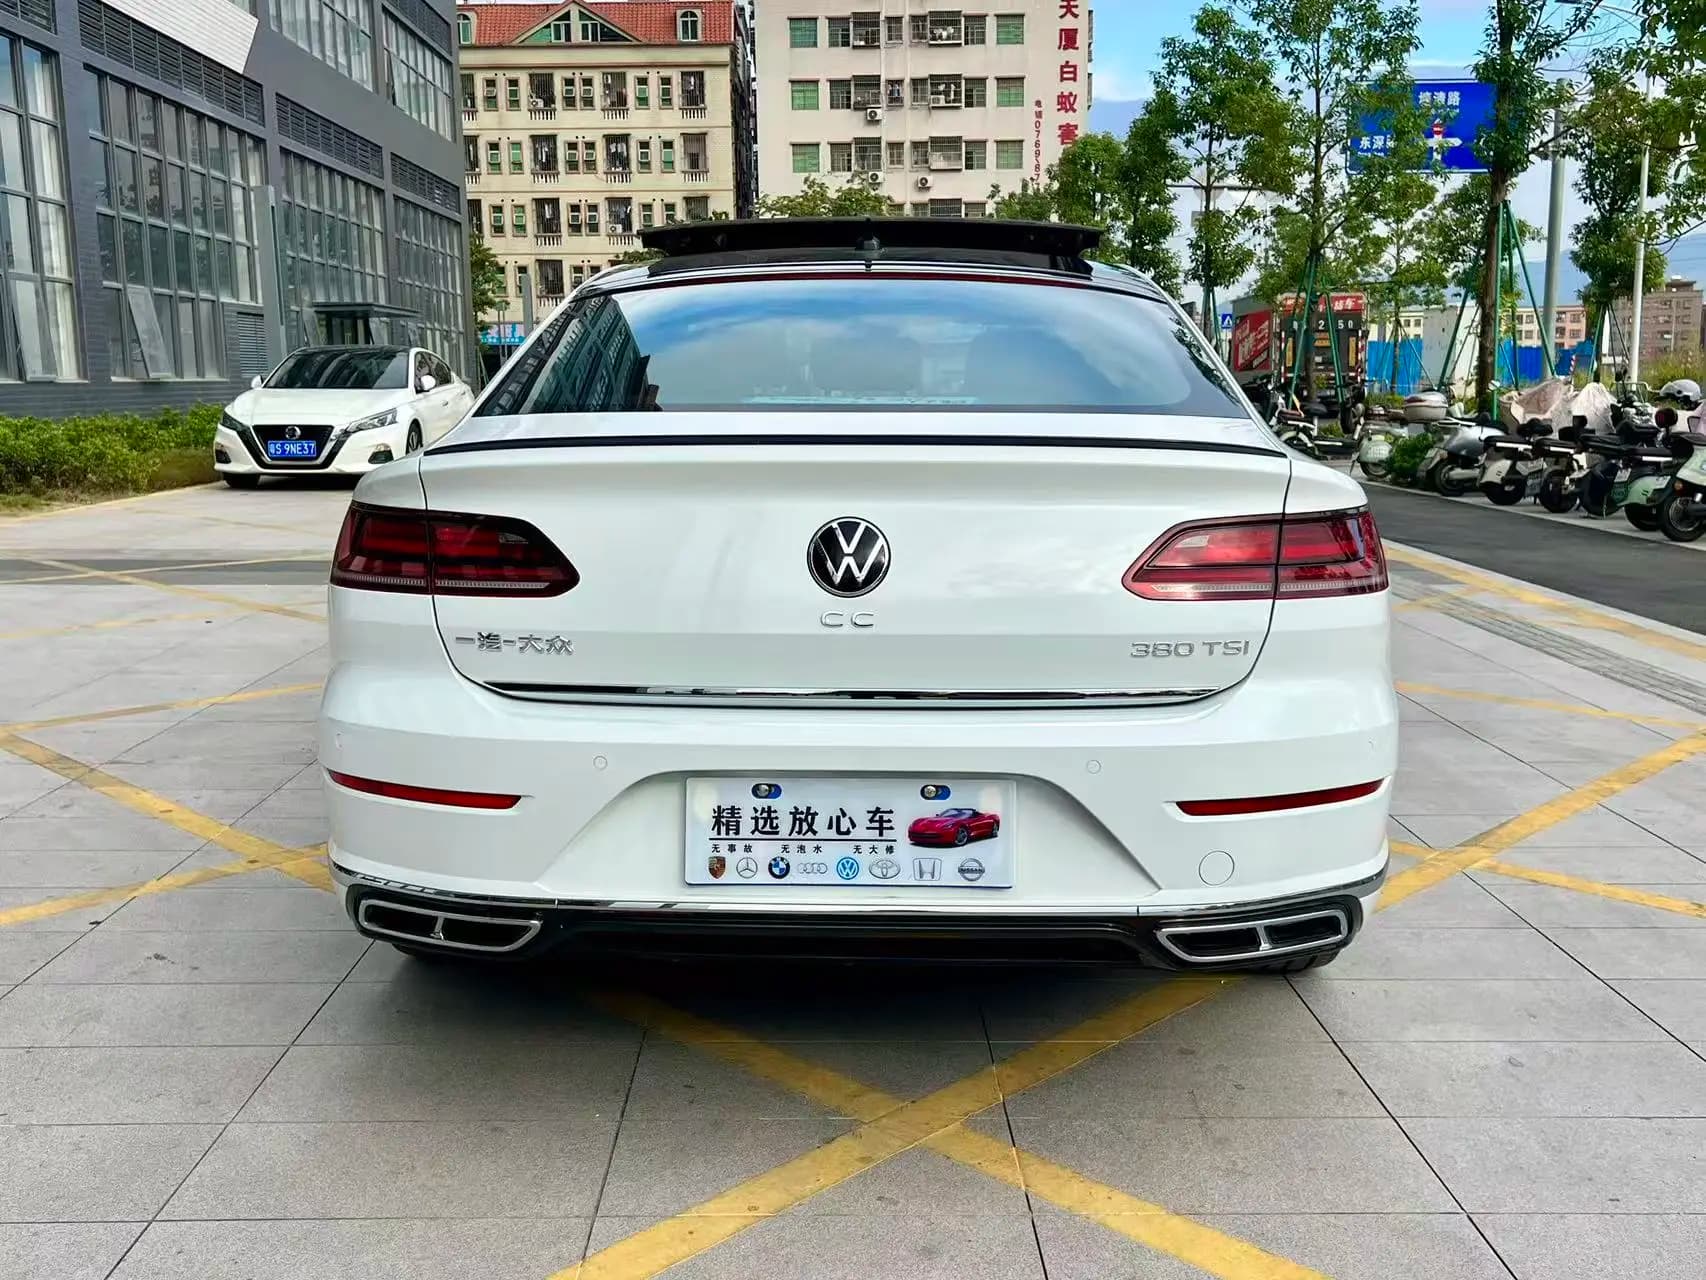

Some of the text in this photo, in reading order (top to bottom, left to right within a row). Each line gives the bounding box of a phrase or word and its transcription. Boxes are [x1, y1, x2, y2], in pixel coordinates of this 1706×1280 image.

[820, 610, 875, 629] CC
[1130, 639, 1250, 658] 380 TSI
[711, 805, 896, 837] 精选放心车
[711, 844, 753, 854] 无事故
[781, 844, 823, 854] 无泡水
